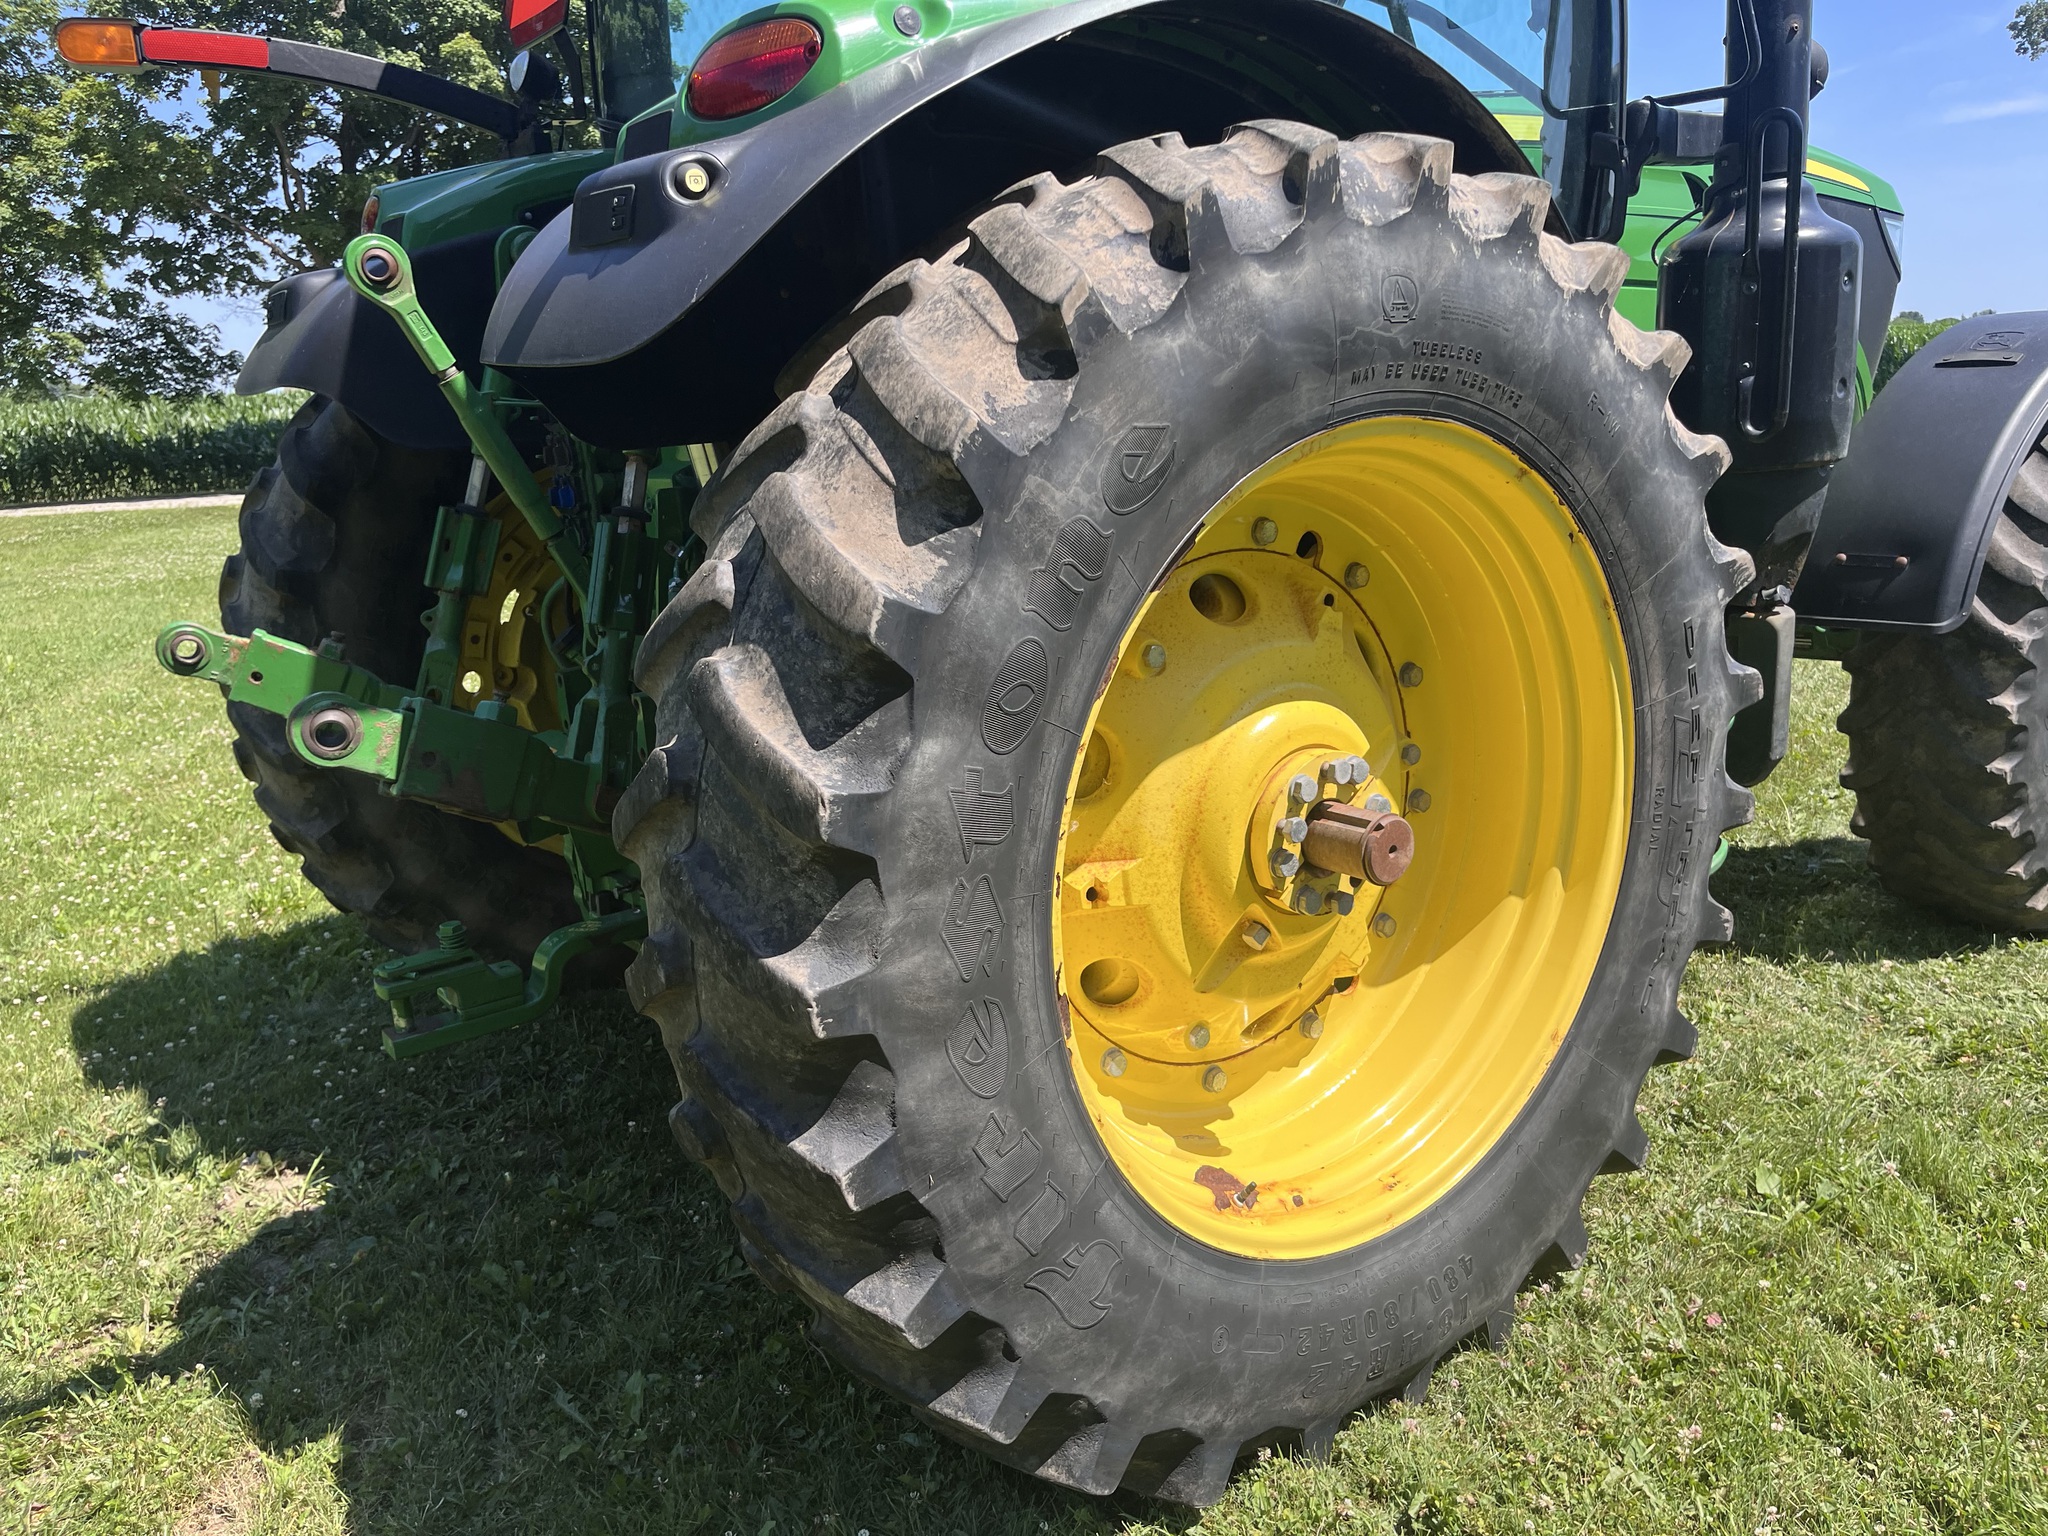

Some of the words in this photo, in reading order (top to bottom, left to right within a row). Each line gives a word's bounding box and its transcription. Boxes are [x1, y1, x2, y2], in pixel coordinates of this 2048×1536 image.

[1350, 364, 1378, 387] MAY
[1384, 361, 1405, 380] BE
[1410, 362, 1450, 383] USED
[1455, 367, 1490, 394] TUBE
[1493, 382, 1524, 410] TYPE
[1412, 339, 1483, 365] TUBELESS
[1587, 389, 1622, 439] R-1W
[1683, 616, 1701, 784] DEEP
[1647, 784, 1666, 857] RADIAL
[939, 423, 1177, 1330] Firestone
[1296, 1253, 1475, 1357] 480/80R42
[1301, 1292, 1470, 1399] 18.4R42
